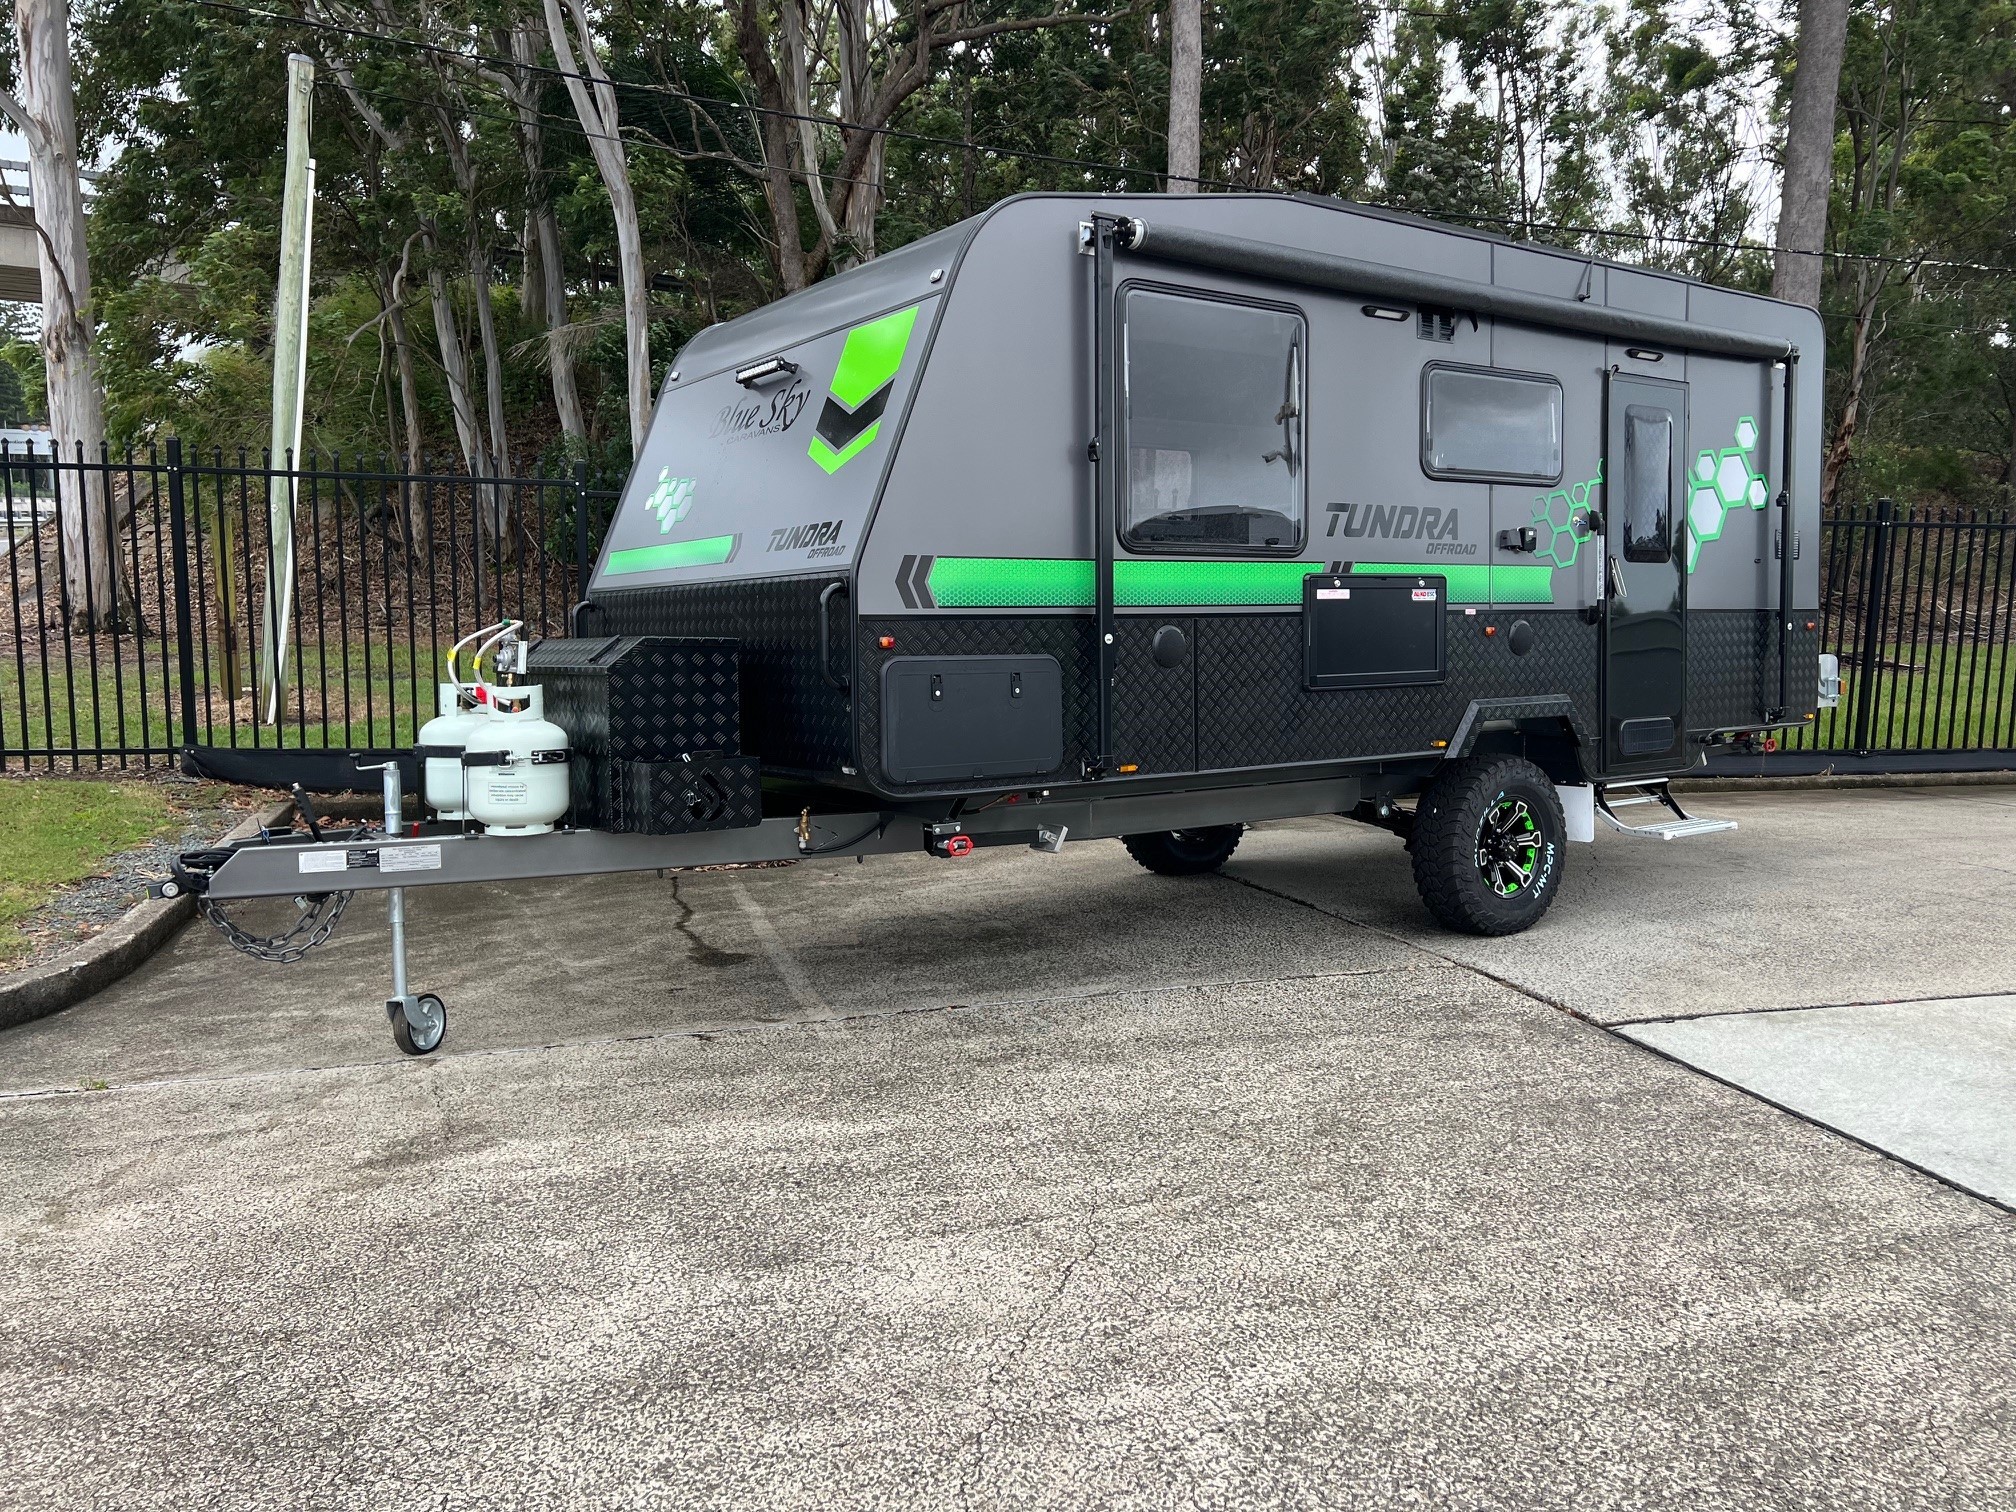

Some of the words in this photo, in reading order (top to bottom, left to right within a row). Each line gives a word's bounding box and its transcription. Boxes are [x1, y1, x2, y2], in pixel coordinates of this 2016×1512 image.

[709, 396, 761, 439] Blue
[760, 379, 811, 432] Sky
[726, 424, 781, 444] CARAVANS
[766, 519, 844, 553] TUNDRA
[1326, 502, 1459, 541] TUNDRA
[807, 545, 847, 560] OFFROAD
[1425, 542, 1477, 556] OFFROAD
[1533, 842, 1555, 899] MPC-M/T
